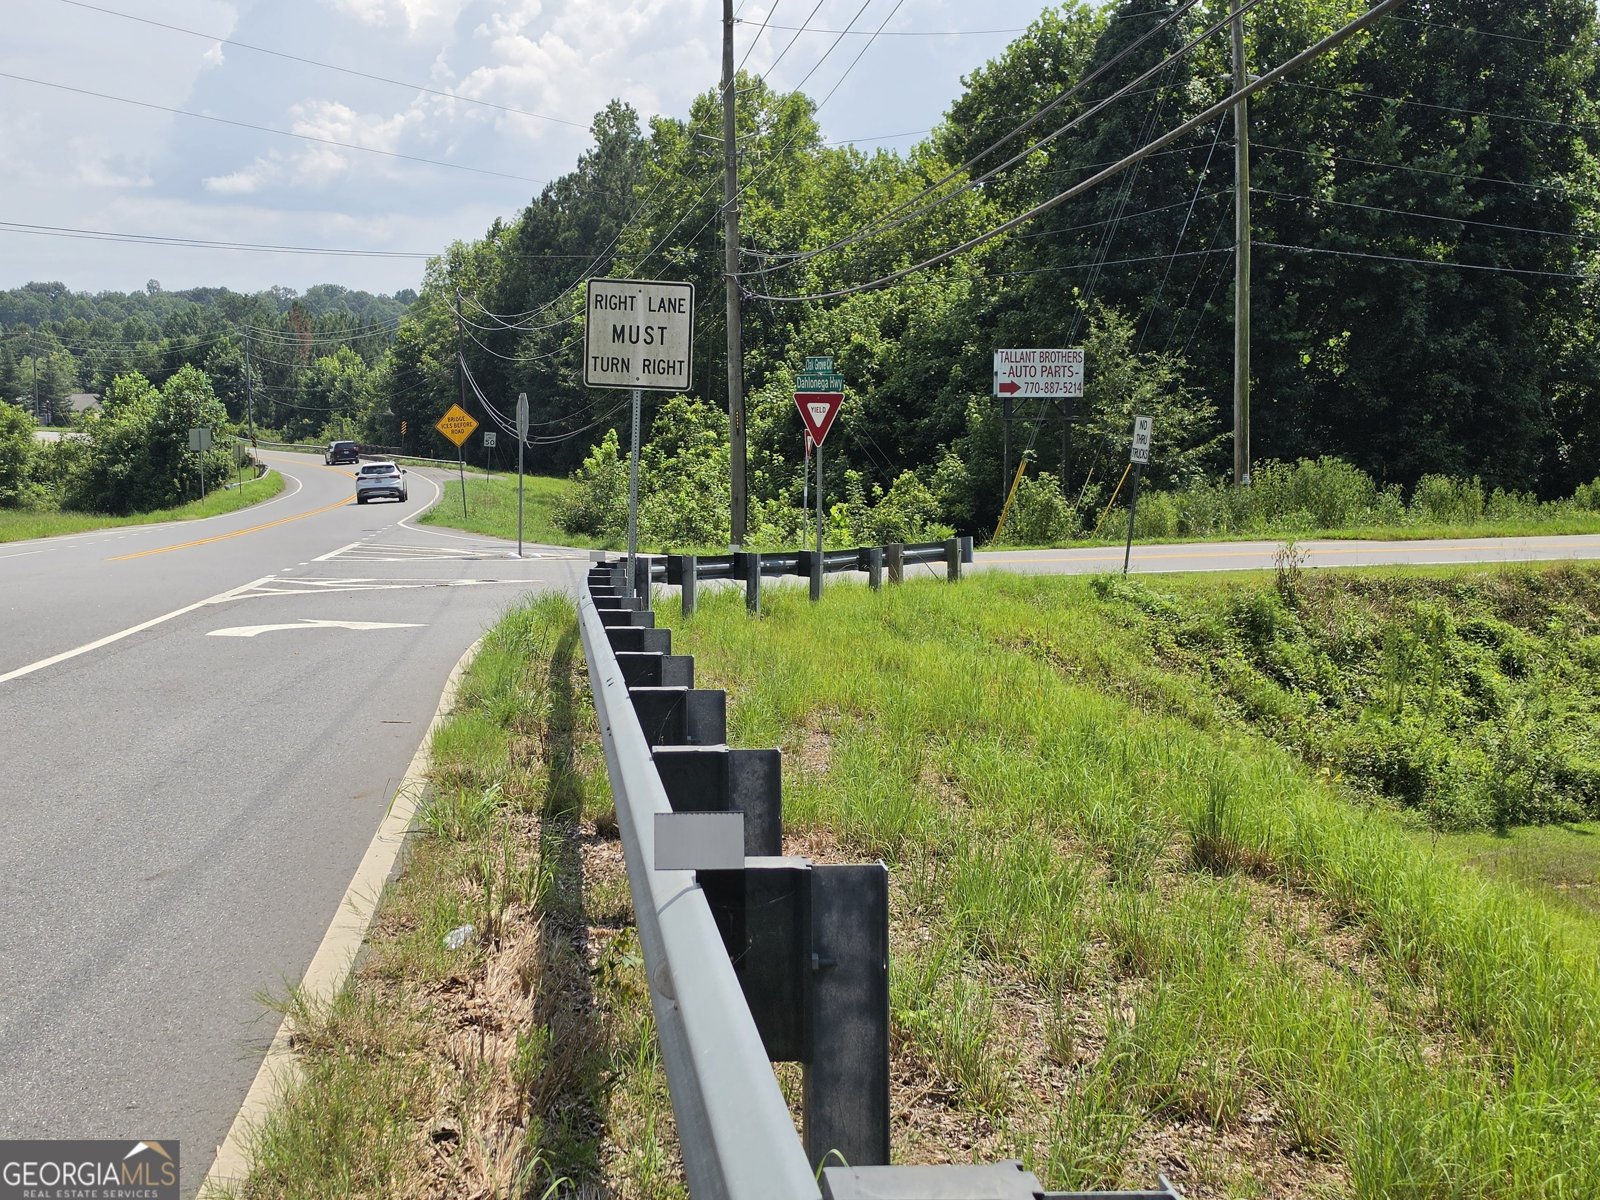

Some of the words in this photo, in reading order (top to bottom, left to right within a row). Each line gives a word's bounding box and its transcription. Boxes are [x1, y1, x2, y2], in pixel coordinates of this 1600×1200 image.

[594, 294, 636, 311] RIGHT
[648, 297, 686, 314] LANE
[612, 324, 667, 346] MUST
[999, 351, 1037, 363] TALLANT
[1040, 351, 1083, 363] BROTHERS
[592, 356, 630, 373] TURN
[642, 359, 685, 376] RIGHT
[796, 377, 829, 391] Dahlonega
[830, 376, 843, 391] Hwy
[1024, 382, 1082, 394] 770-887-5214
[811, 406, 827, 414] YIELD
[1139, 420, 1148, 430] NO
